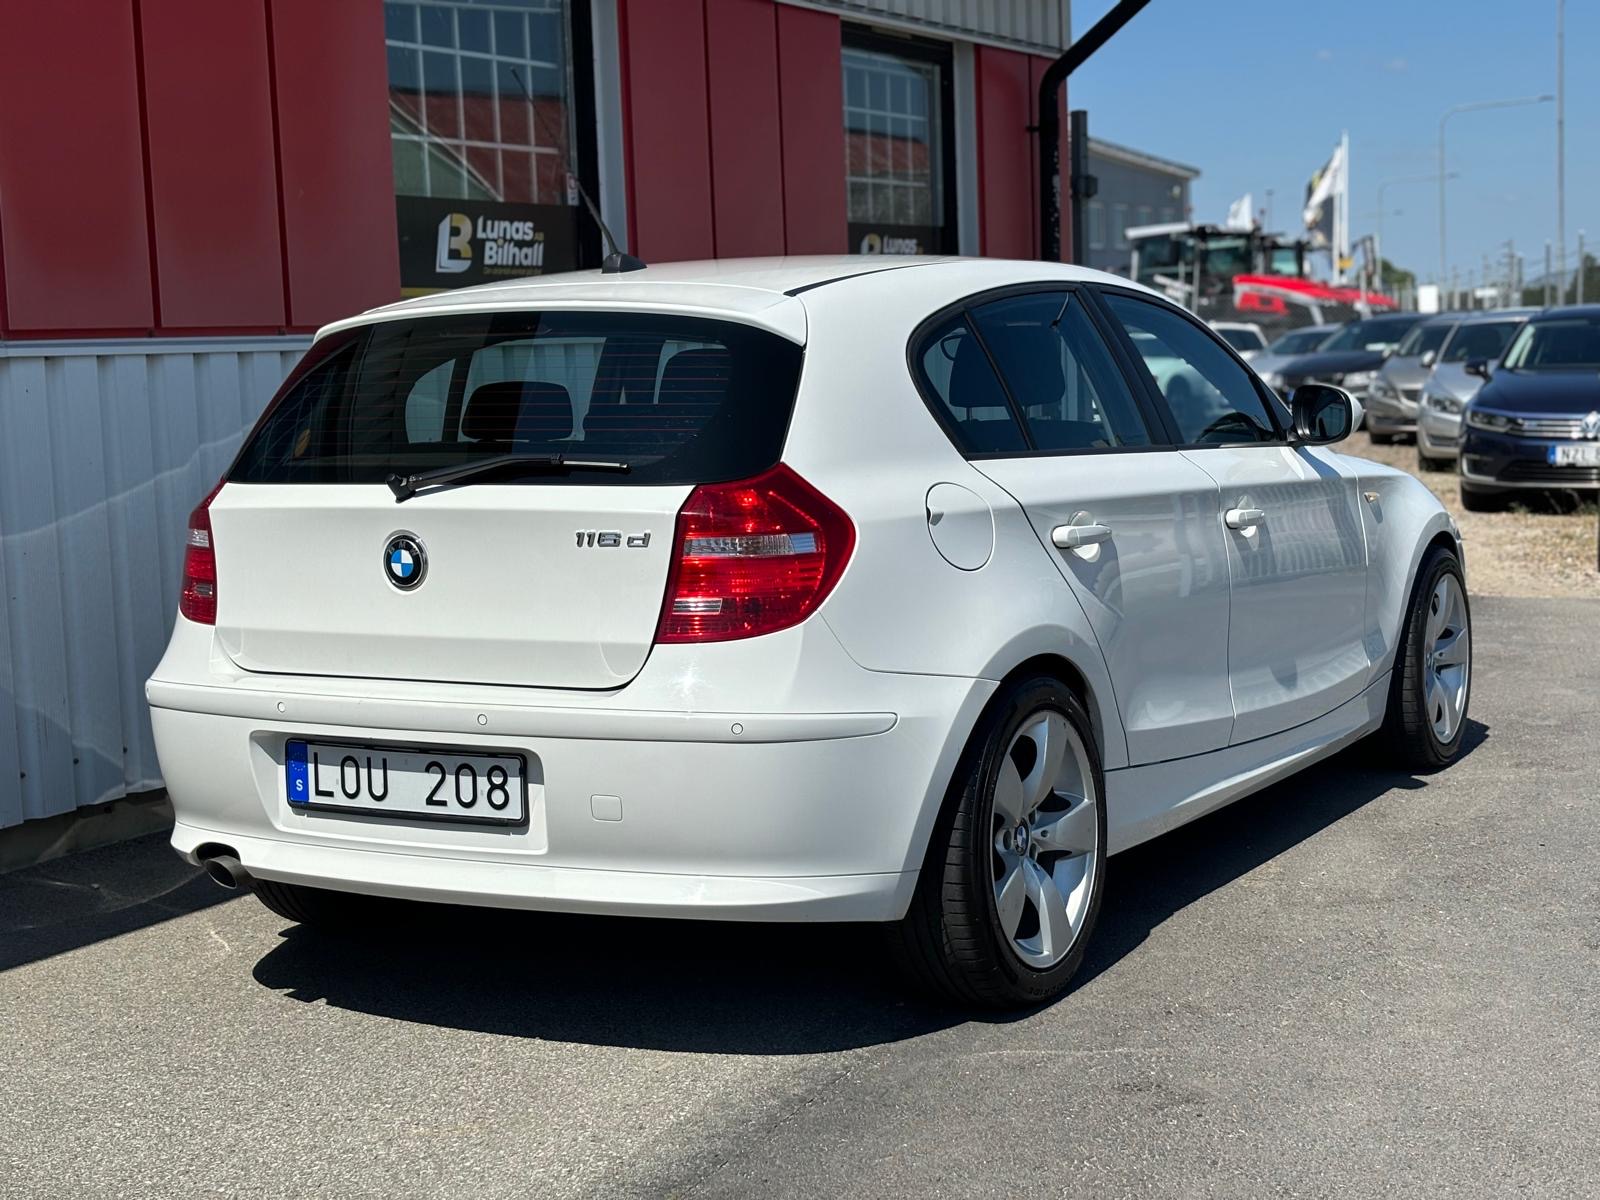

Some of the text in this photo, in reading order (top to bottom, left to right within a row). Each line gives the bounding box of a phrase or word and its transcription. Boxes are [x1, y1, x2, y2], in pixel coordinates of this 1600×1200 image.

[477, 215, 534, 240] Lunas
[483, 239, 544, 266] Bilhall
[883, 234, 918, 254] Lunas
[313, 752, 510, 811] LOU 208
